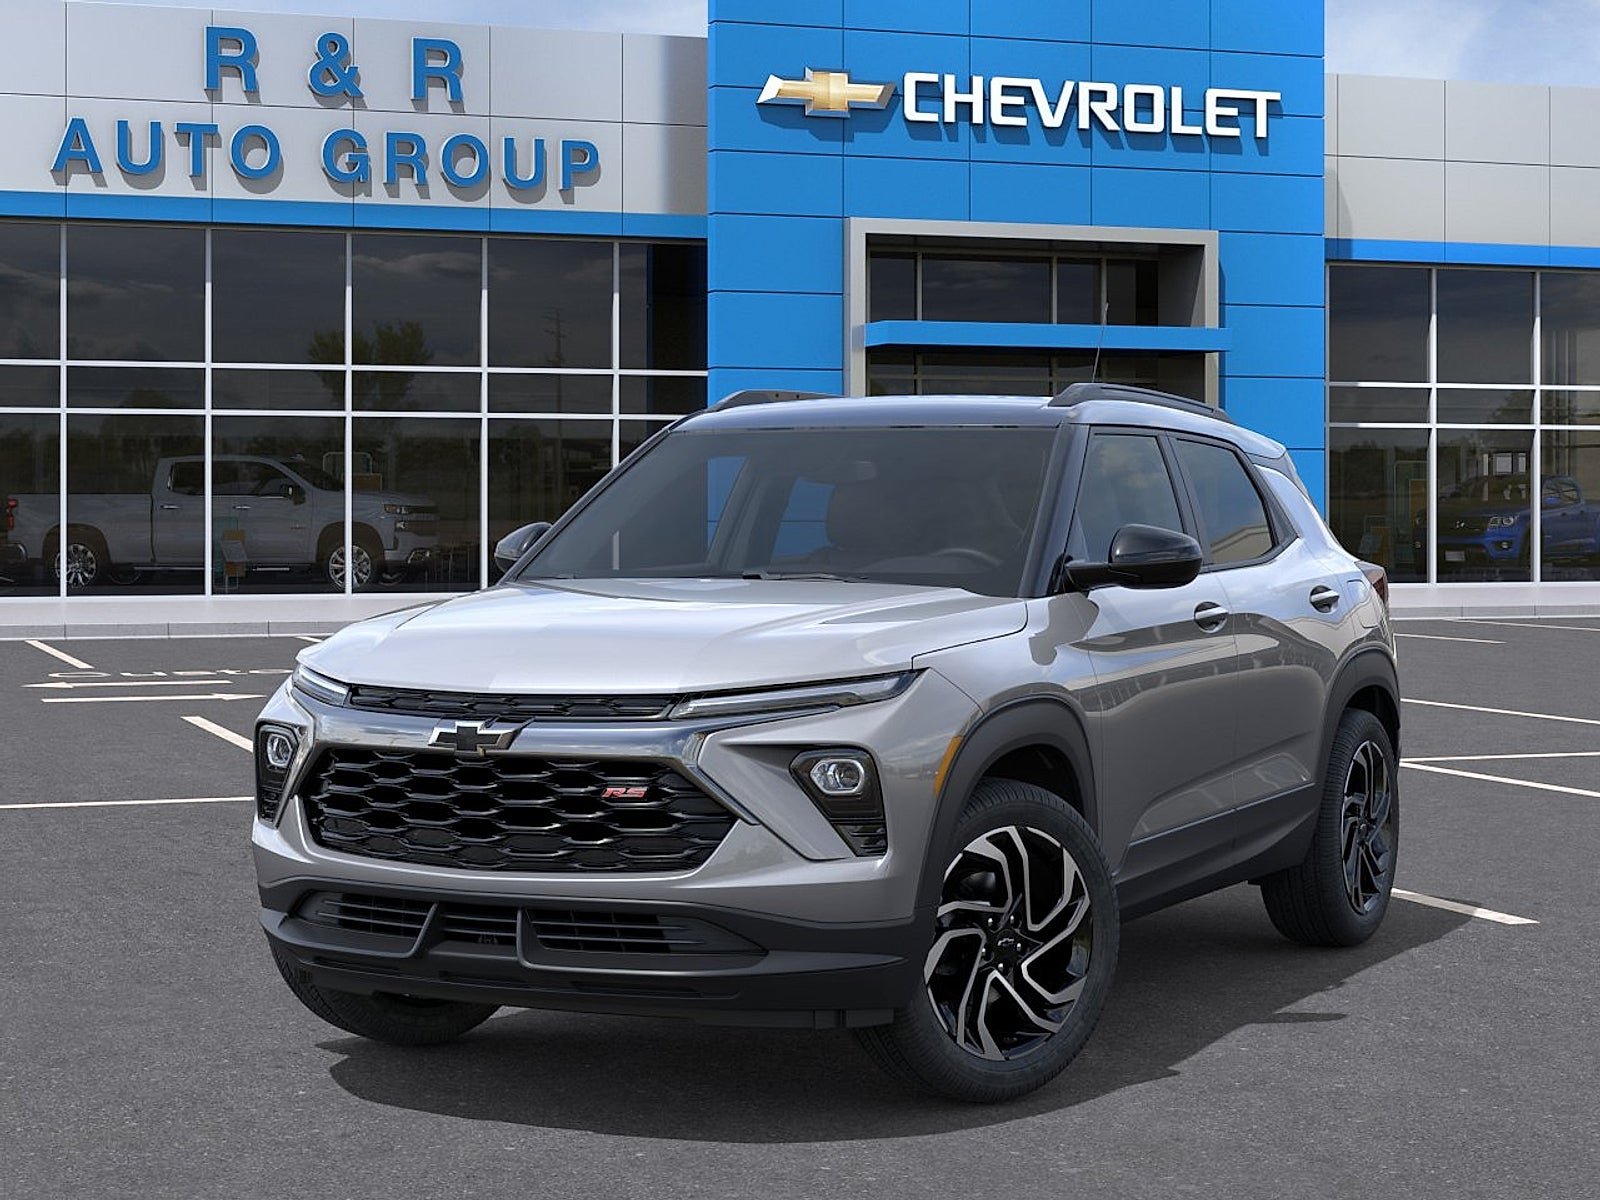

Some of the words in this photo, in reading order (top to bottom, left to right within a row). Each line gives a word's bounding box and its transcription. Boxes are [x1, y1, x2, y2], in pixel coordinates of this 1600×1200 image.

[205, 25, 259, 93] R
[308, 31, 365, 98] &
[412, 37, 464, 102] R
[903, 71, 1282, 139] CHEVROLET
[51, 116, 282, 181] AUTO
[322, 127, 600, 193] GROUP
[602, 786, 648, 798] RS
